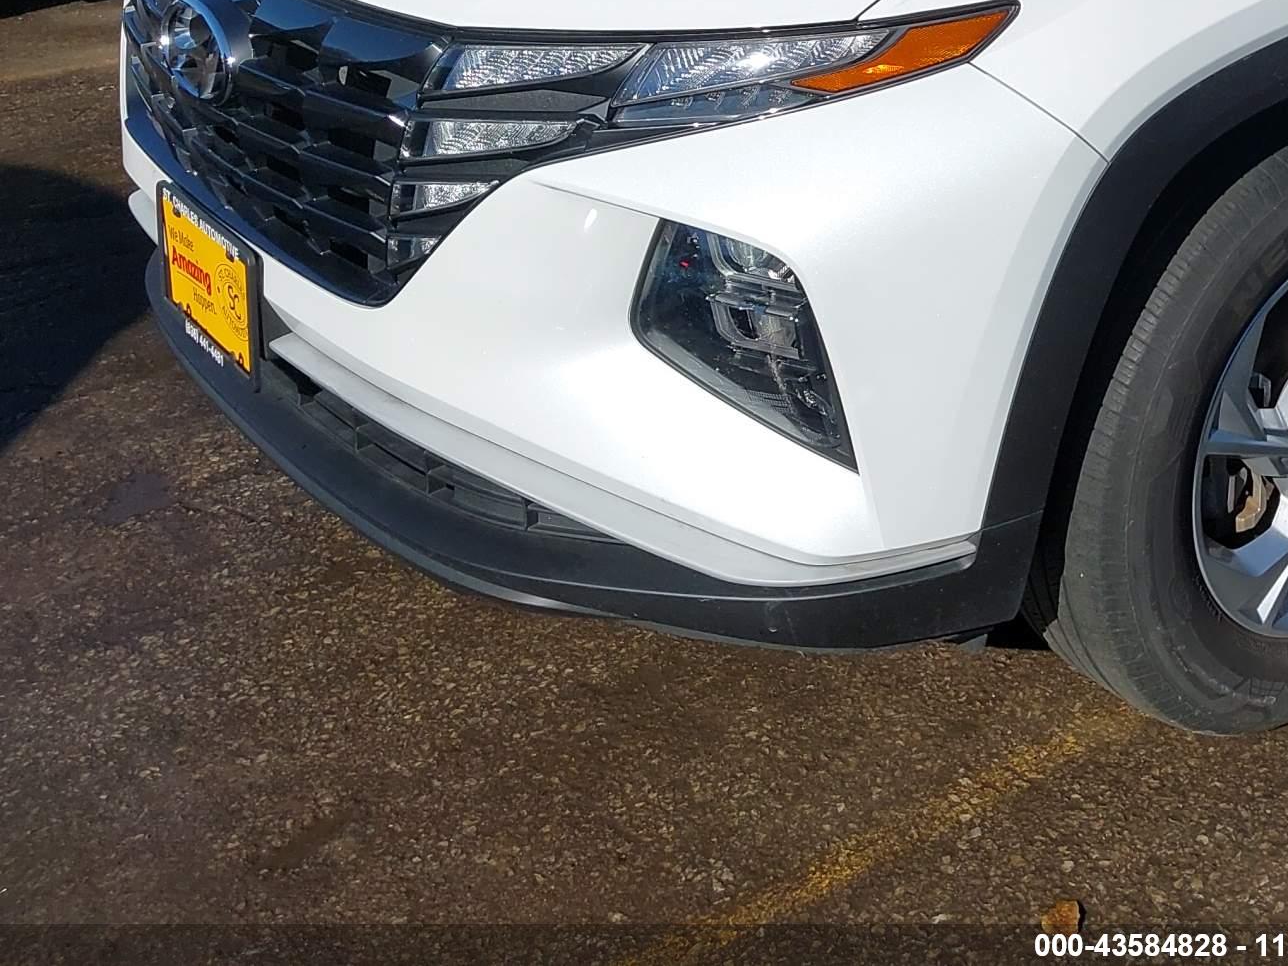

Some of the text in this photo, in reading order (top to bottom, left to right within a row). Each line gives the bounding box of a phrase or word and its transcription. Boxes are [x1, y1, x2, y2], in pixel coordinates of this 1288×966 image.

[168, 224, 179, 244] We
[172, 195, 199, 225] CHARLES
[199, 219, 239, 260] AUTOMOTIVE
[172, 246, 212, 296] Amazing
